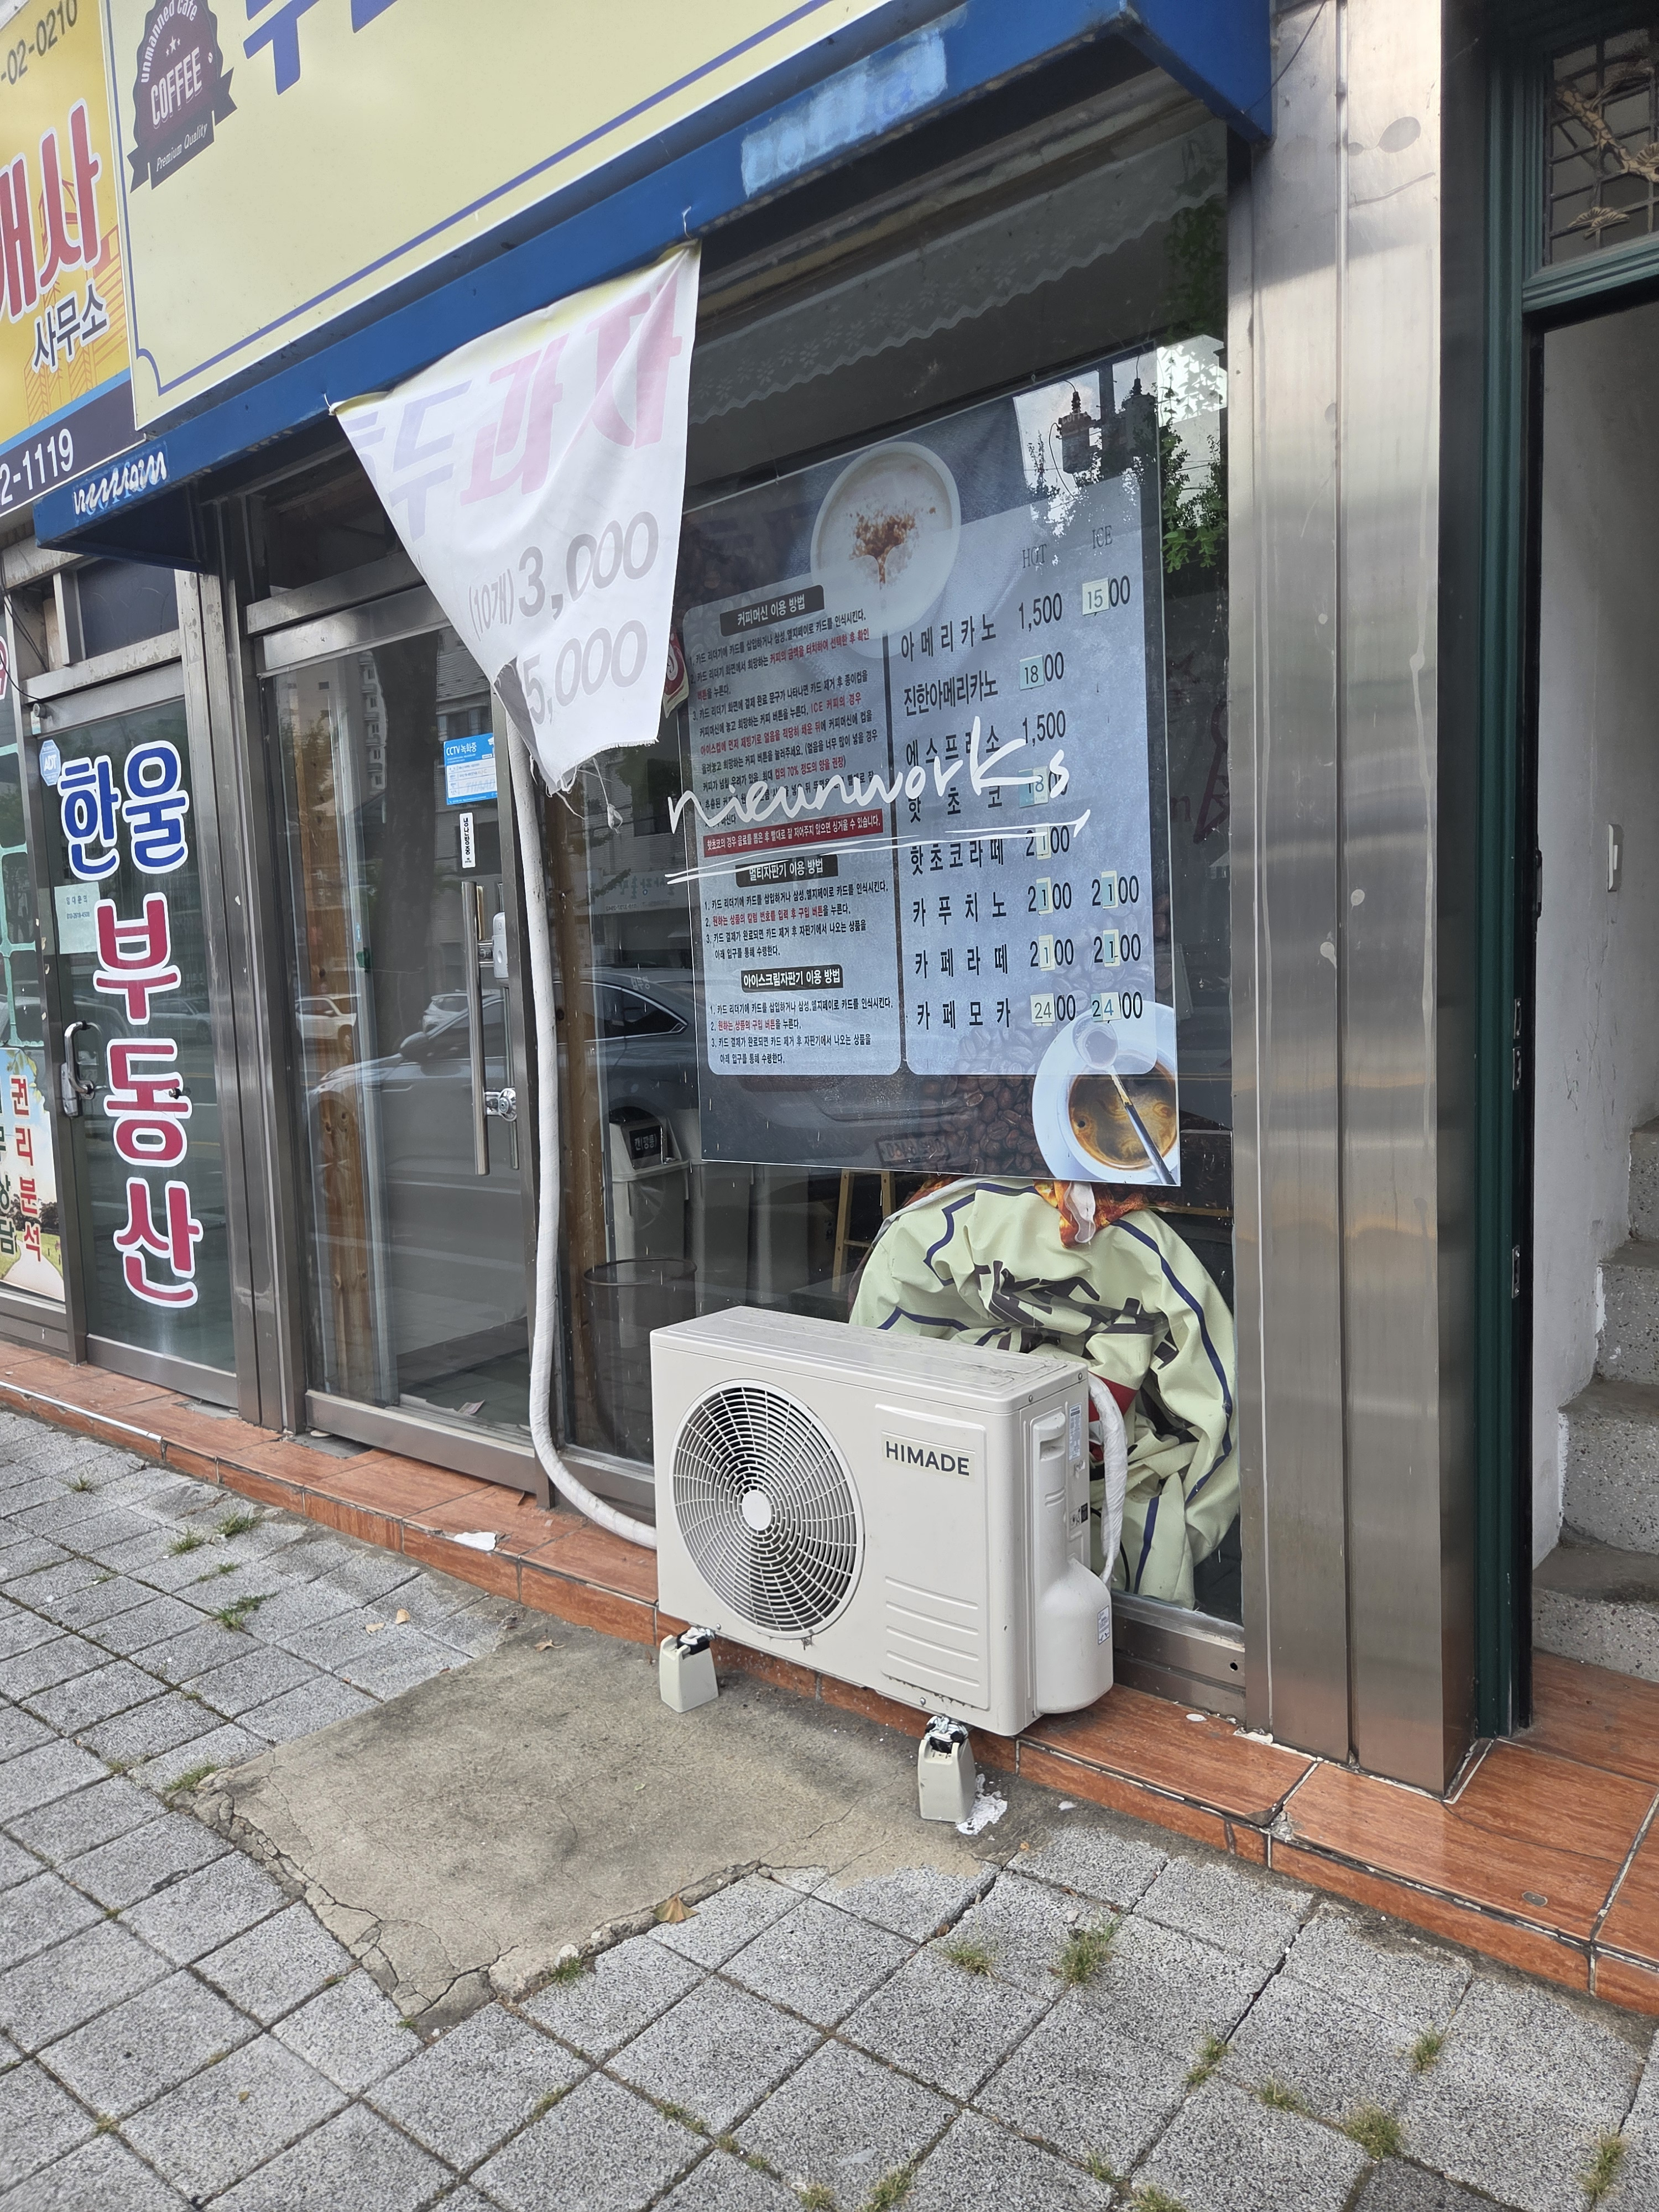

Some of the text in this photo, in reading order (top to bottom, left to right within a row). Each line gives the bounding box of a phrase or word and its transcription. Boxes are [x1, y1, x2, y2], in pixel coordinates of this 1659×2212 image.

[150, 46, 202, 127] COFFEE
[156, 123, 208, 172] Premium Quality
[33, 283, 108, 368] 사무소
[1022, 525, 1113, 568] HOT ICE
[518, 511, 659, 621] 3,000
[737, 593, 805, 628] 커피머신 이용 방법
[1018, 592, 1063, 632] 1,500
[904, 670, 998, 716] 진한아메리카노
[1022, 710, 1066, 744] 1,500
[44, 754, 57, 771] ADT
[446, 742, 477, 757] CCTV 녹화중
[59, 744, 188, 877] 한울
[749, 858, 823, 881] 멀티자판기 이용 방법
[705, 899, 709, 911] 1.
[712, 898, 722, 910] 카드
[724, 896, 744, 909] 리더기에
[746, 894, 762, 906] 카드를
[764, 891, 791, 905] 삽입하거나
[836, 884, 853, 898] 카드를
[913, 891, 1007, 927] 카푸치노
[705, 916, 710, 927] 2.
[712, 915, 727, 927] 원하는
[729, 913, 745, 925] 상품의
[760, 910, 775, 922] 번호를
[778, 909, 788, 921] 입력
[790, 908, 796, 920] 후
[798, 907, 809, 919] 구입
[812, 905, 829, 918] 버튼을
[831, 903, 850, 916] 누른다.
[706, 920, 866, 943] 3. 카드 결제가 완료되면 카드 제거 후 자판기에서 나오는 상품을
[714, 945, 780, 960] 아래 입구를 통해 수령한다.
[915, 943, 1008, 979] 카페라떼
[743, 968, 840, 988] 아이스크림자판기 이용 방법
[710, 1004, 715, 1014] 1.
[717, 1004, 727, 1014] 카드
[729, 1003, 749, 1014] 리더기에
[751, 1002, 767, 1013] 카드를
[769, 1001, 796, 1013] 삽입하거나
[841, 999, 858, 1010] 카드를
[917, 998, 1010, 1030] 카페모카
[711, 1019, 801, 1031] 2. 원하는 상품의 구입 버튼을 누른다.
[711, 1034, 871, 1047] 3. 카드 결제가 완료되면 카드 제거 후 자판기에서 나오는 상품을
[719, 1053, 784, 1064] 아래 입구를 통해 수령한다.
[95, 896, 202, 1304] 부동산
[10, 1076, 42, 1262] 권리분석
[886, 1441, 970, 1477] HIMADE
